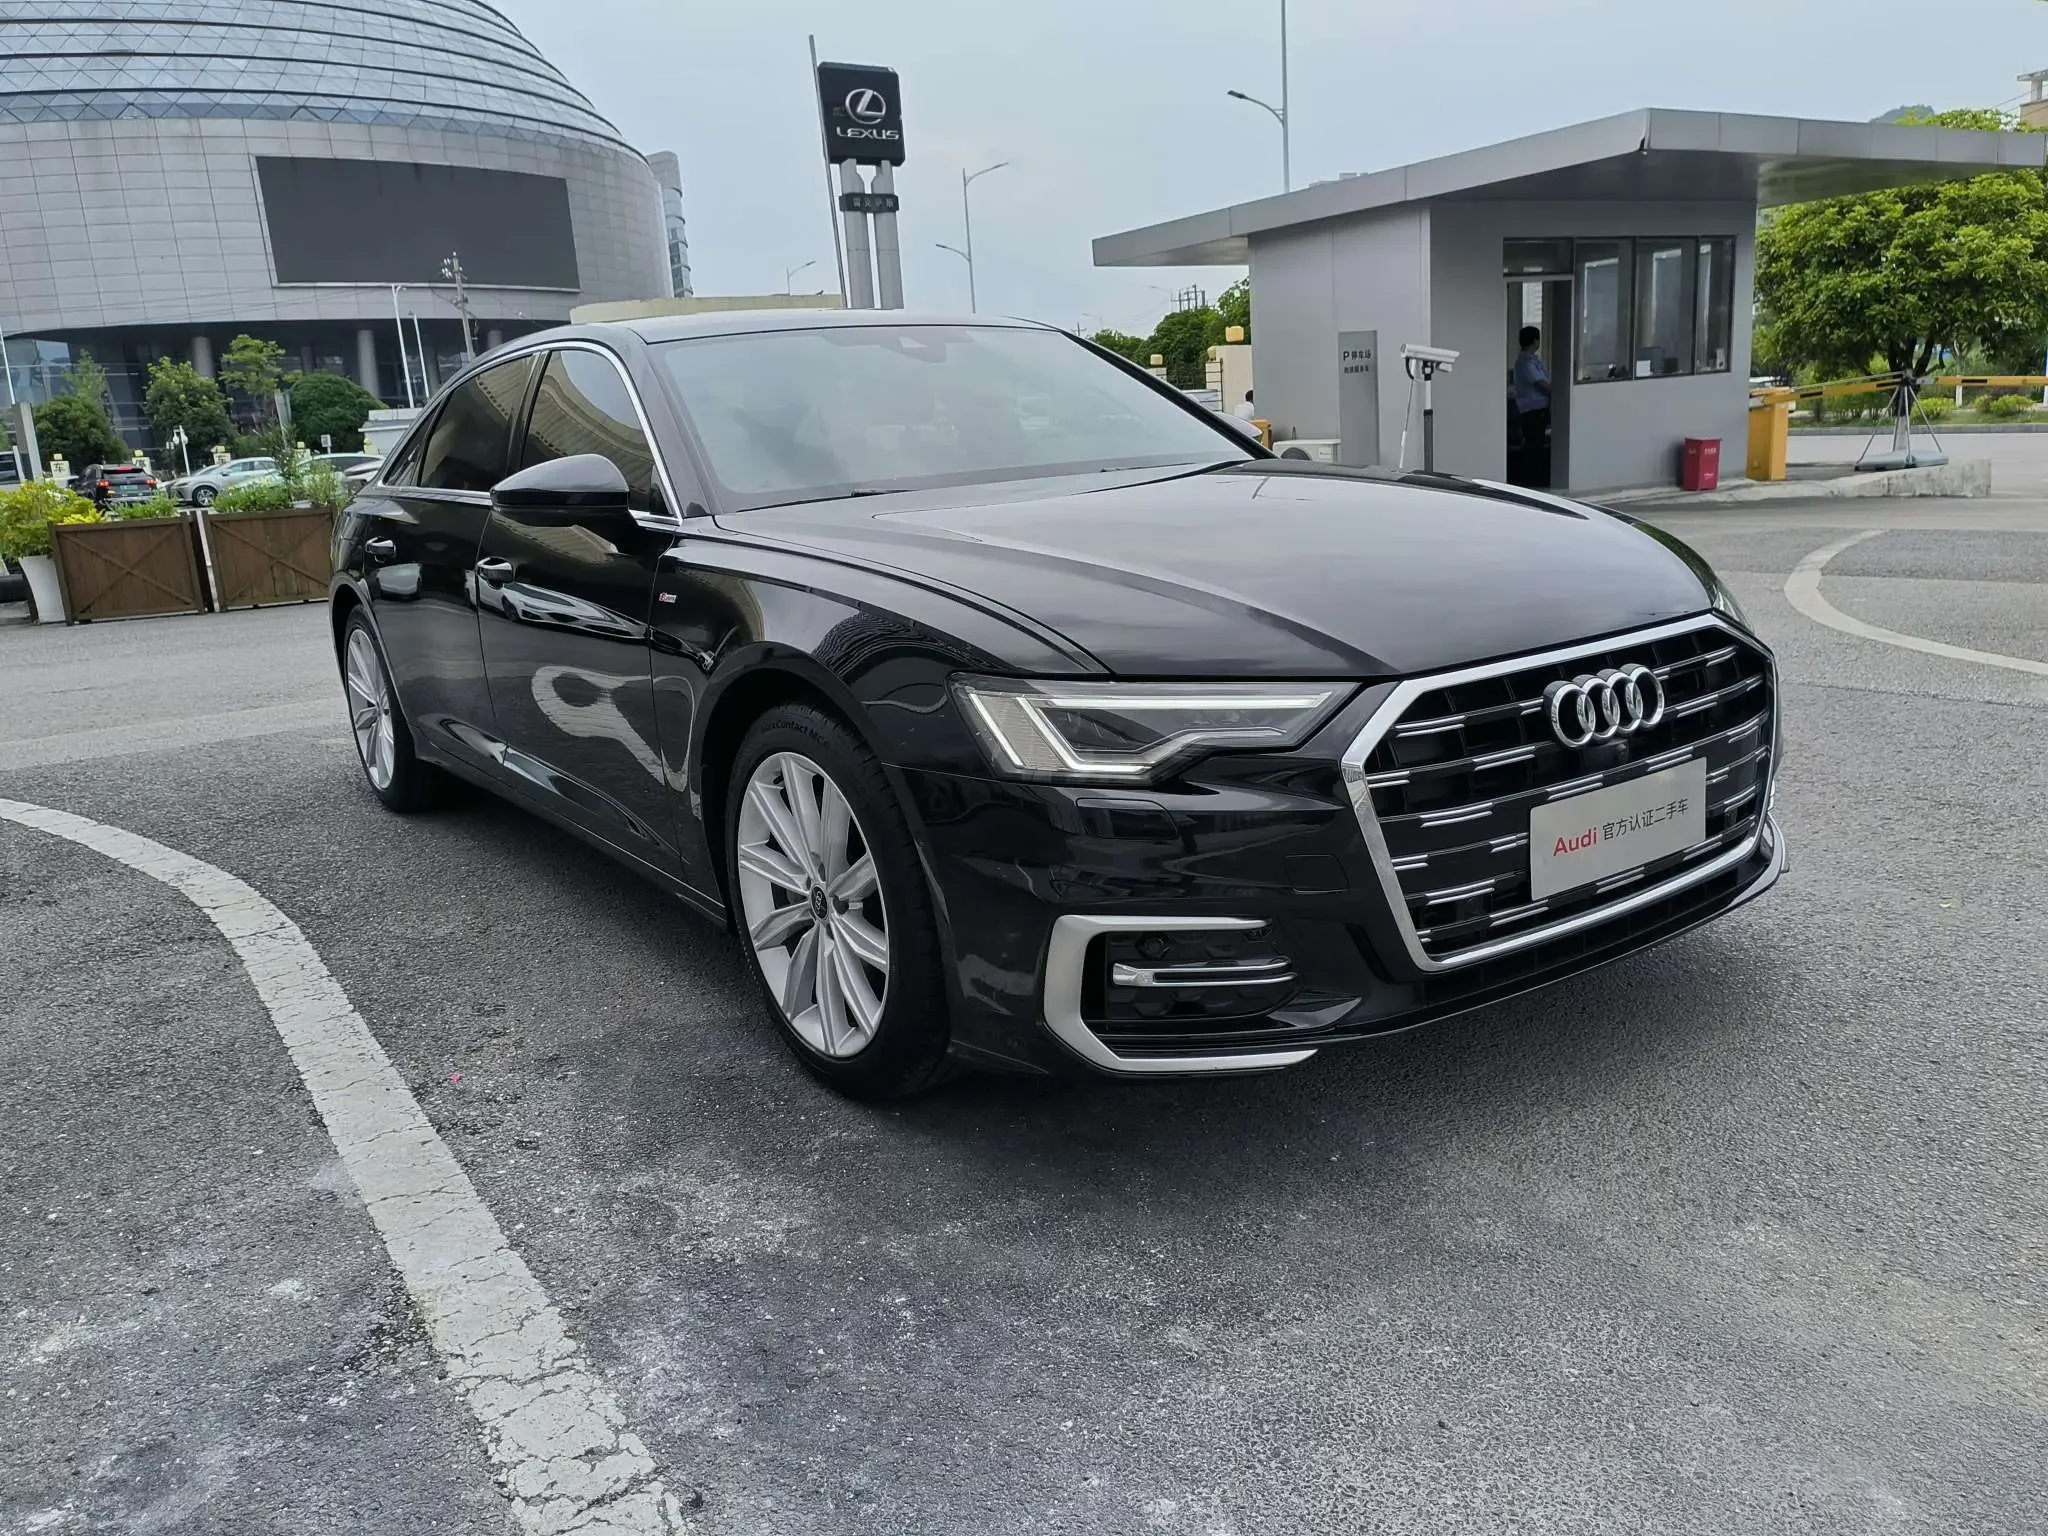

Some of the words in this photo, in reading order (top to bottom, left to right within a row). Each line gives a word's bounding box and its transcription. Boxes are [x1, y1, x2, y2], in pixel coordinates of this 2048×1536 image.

[836, 126, 900, 140] LEXUS
[1553, 827, 1597, 856] Audi
[1602, 798, 1689, 841] 官方认证二手车
